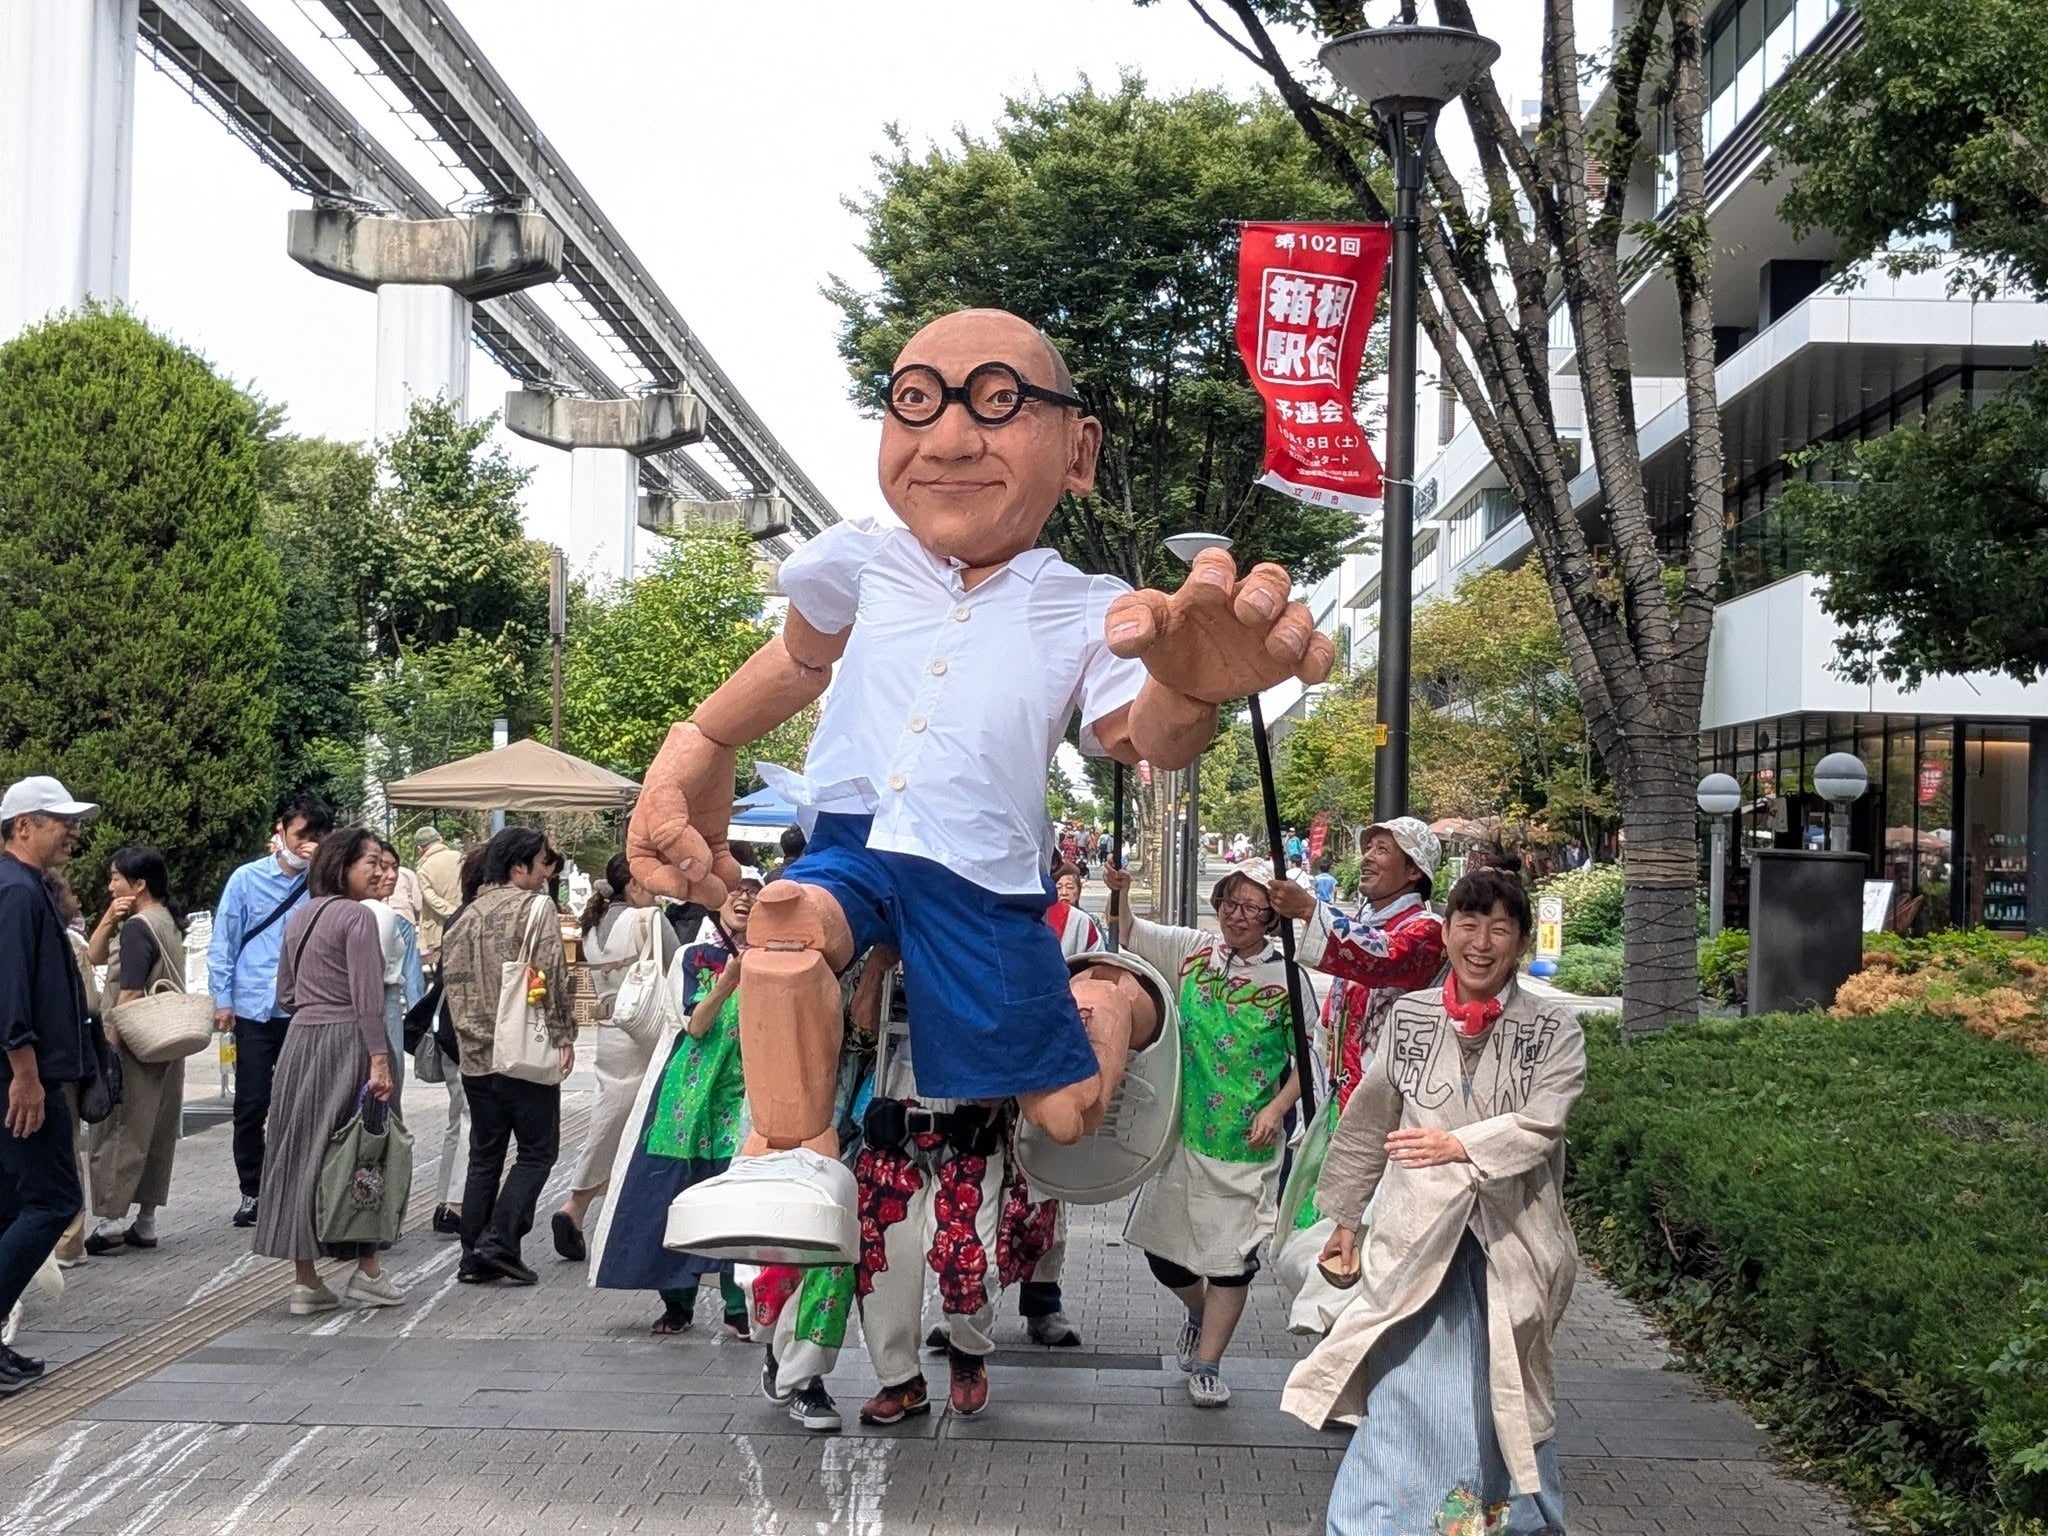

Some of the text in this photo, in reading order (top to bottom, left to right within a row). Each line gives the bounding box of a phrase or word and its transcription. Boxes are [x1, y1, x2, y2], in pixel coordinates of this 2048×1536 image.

[1275, 233, 1361, 257] 第102回
[1268, 275, 1350, 329] 箱根
[1263, 330, 1337, 379] 駅伝
[1275, 398, 1343, 424] 予選会
